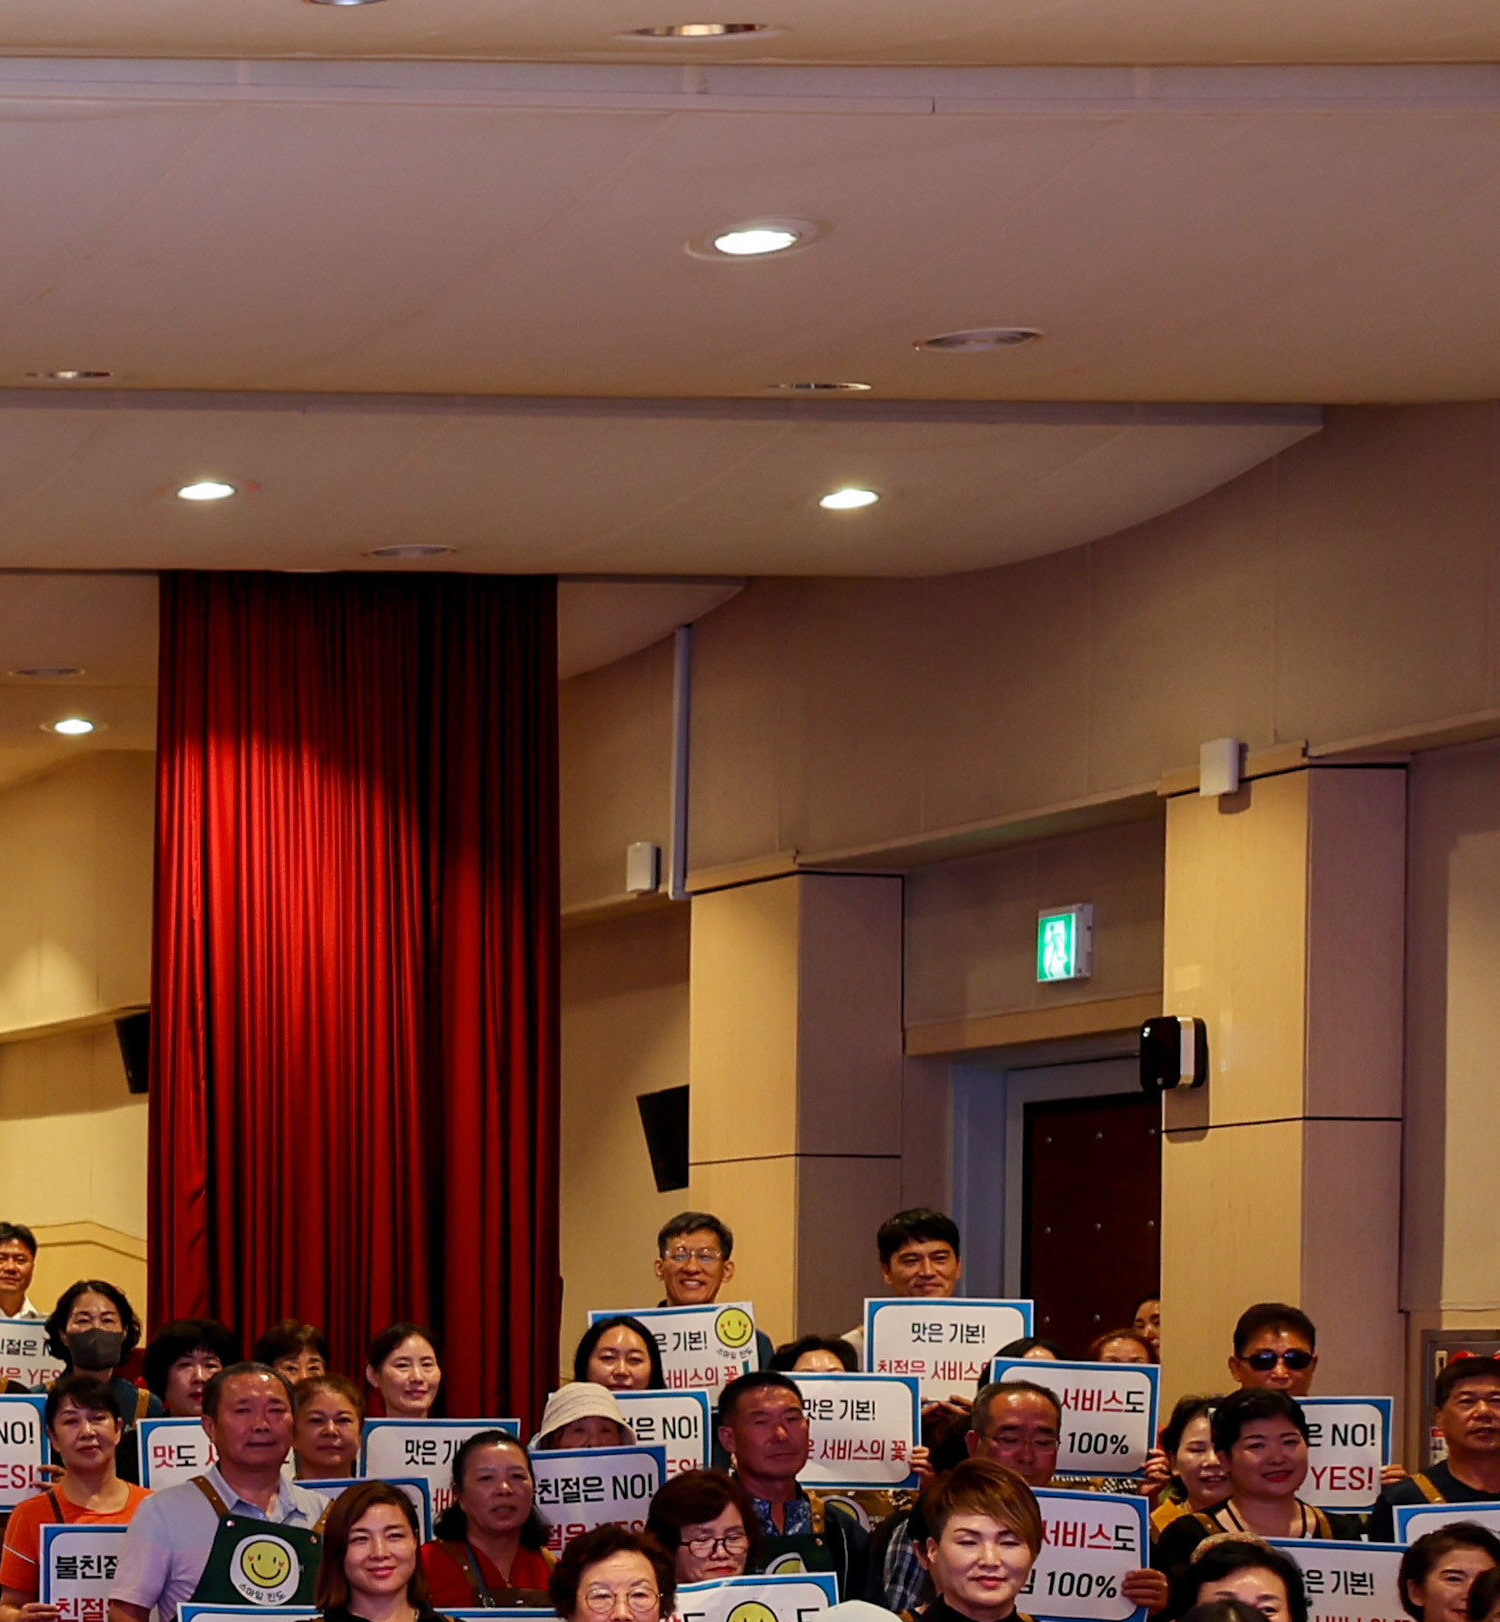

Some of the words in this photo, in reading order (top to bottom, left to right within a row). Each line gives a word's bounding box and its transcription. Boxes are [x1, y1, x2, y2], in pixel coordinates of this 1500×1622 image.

[912, 1323, 943, 1343] 맛은
[949, 1324, 985, 1344] 기본!
[840, 1400, 875, 1421] 기본!
[1061, 1390, 1145, 1413] 서비스도
[662, 1416, 698, 1440] NO!
[1332, 1424, 1375, 1447] NO!
[820, 1439, 885, 1461] 서비스의
[1068, 1432, 1129, 1455] 100%
[153, 1445, 197, 1468] 맛도
[613, 1473, 653, 1500] NO!
[1311, 1466, 1373, 1490] YES!
[1042, 1524, 1136, 1551] 서비스도
[1047, 1571, 1117, 1598] 100%
[1331, 1571, 1374, 1596] 기본!
